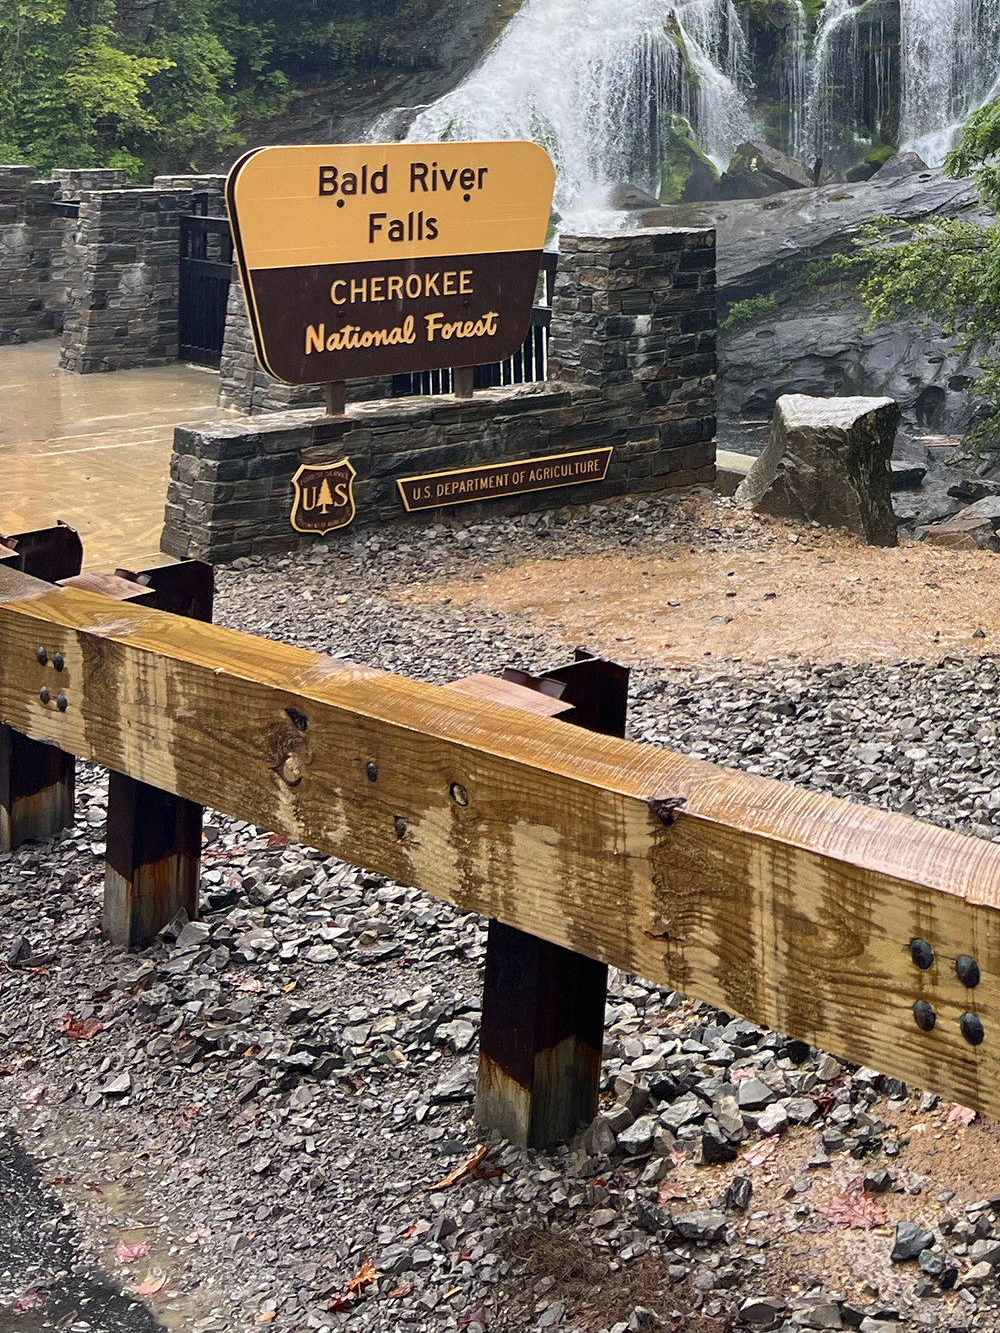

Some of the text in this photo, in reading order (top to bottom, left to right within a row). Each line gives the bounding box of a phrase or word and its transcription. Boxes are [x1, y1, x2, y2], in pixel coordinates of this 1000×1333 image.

[319, 161, 488, 196] Bald River
[369, 211, 438, 243] Falls
[330, 270, 474, 305] CHEROKEE
[305, 311, 499, 355] National Forest
[413, 459, 600, 500] U.S. DEPARTMENT OF AGRICULTURE
